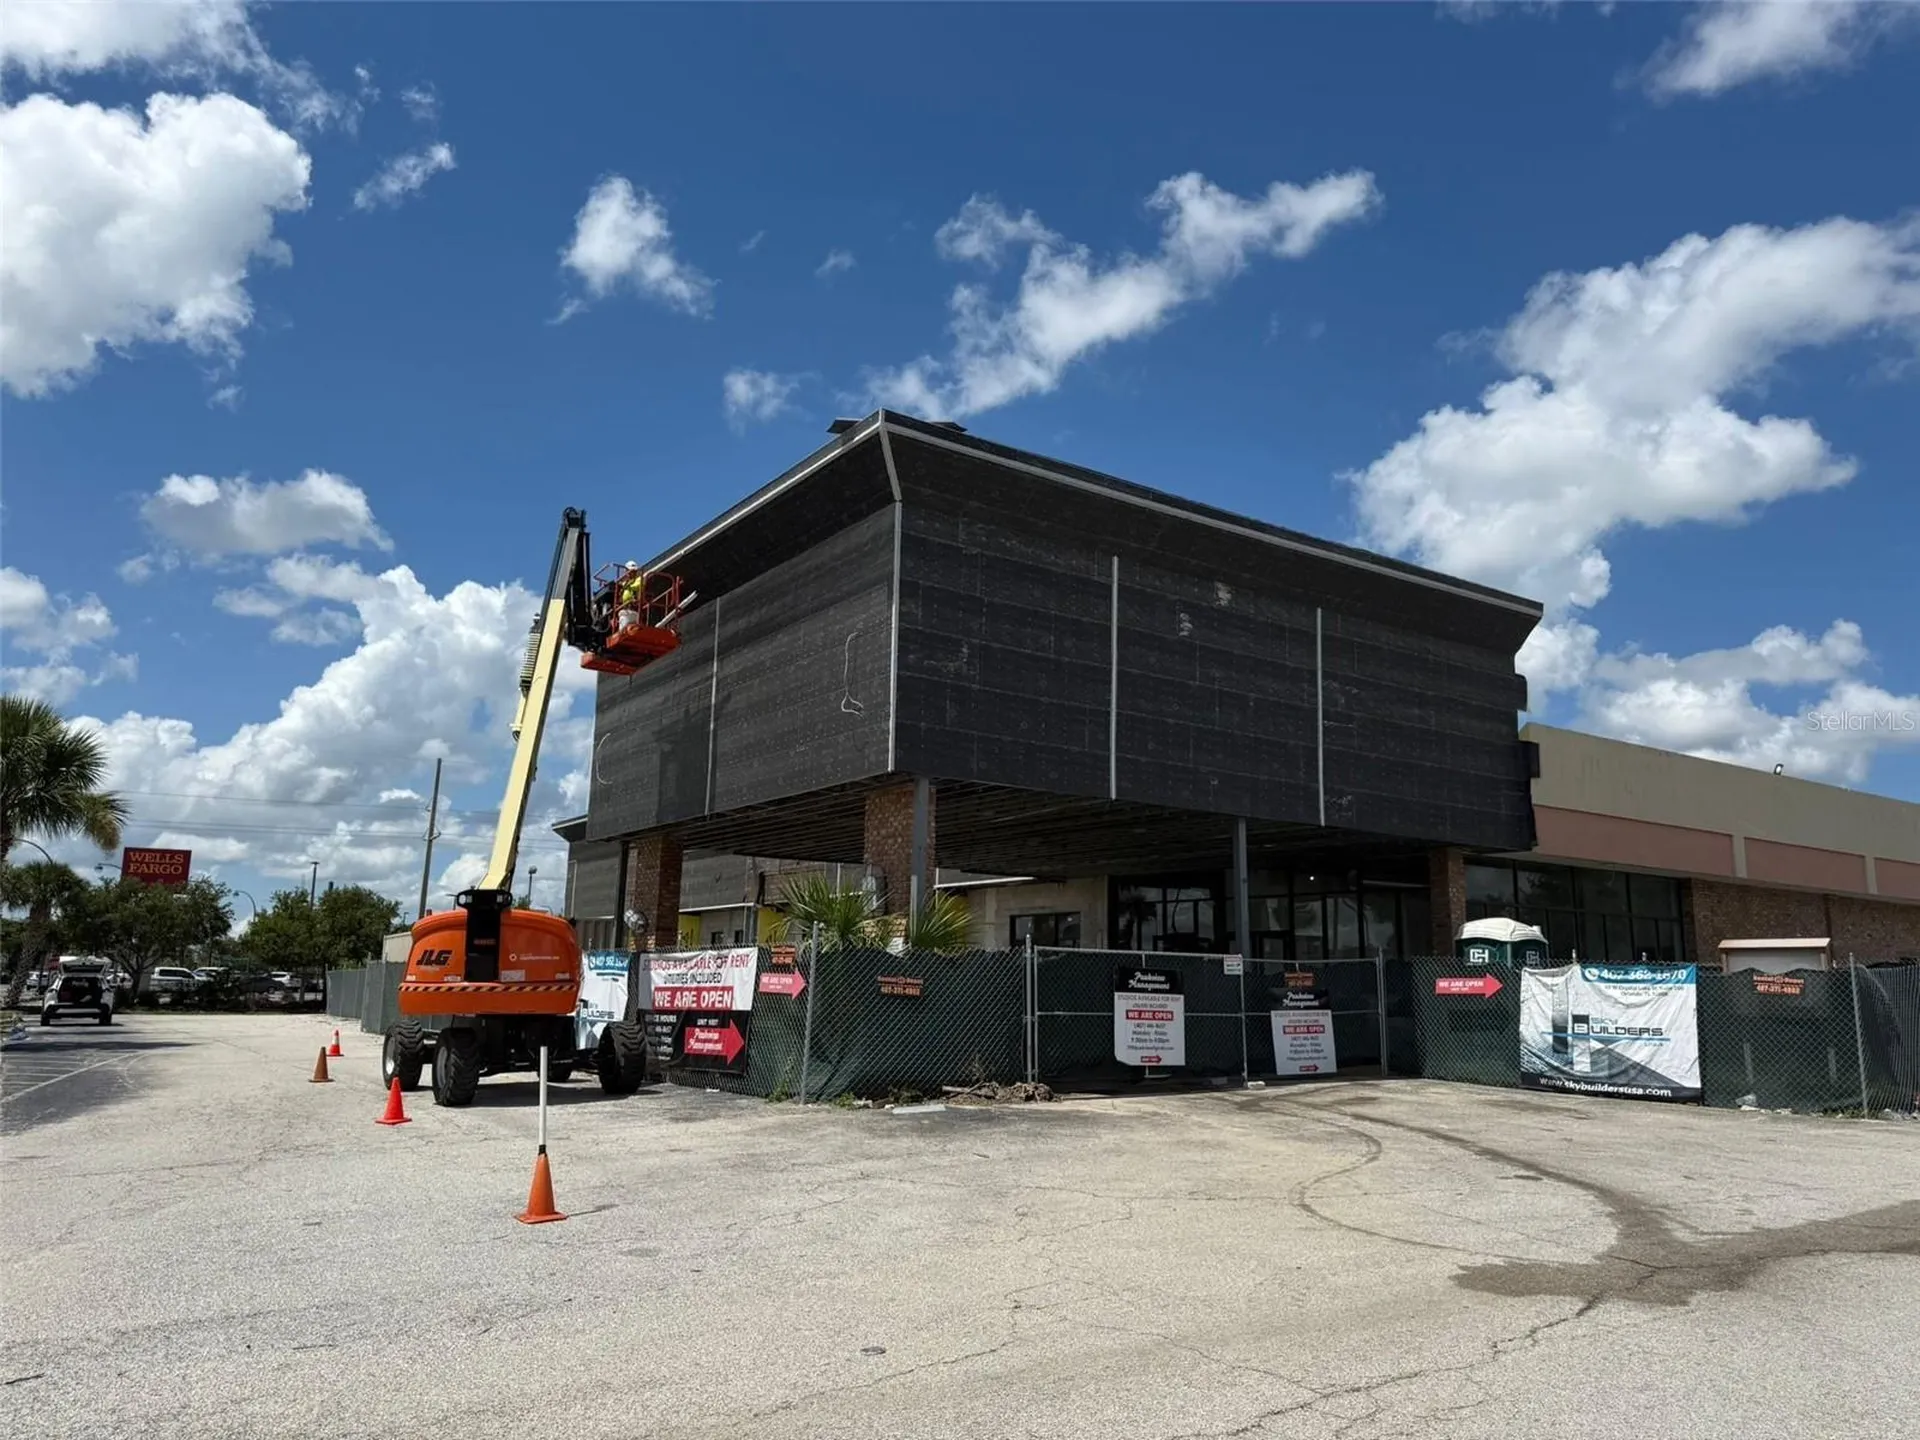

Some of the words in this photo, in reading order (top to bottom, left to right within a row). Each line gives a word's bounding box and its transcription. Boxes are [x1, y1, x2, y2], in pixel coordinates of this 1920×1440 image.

[128, 852, 184, 864] WELLS
[128, 863, 182, 874] FARGO
[416, 950, 452, 966] JLG
[730, 954, 750, 968] RENT
[654, 991, 671, 1008] WE
[674, 991, 698, 1008] ARE
[700, 990, 732, 1008] OPEN
[1574, 1023, 1663, 1036] BUILDERS
